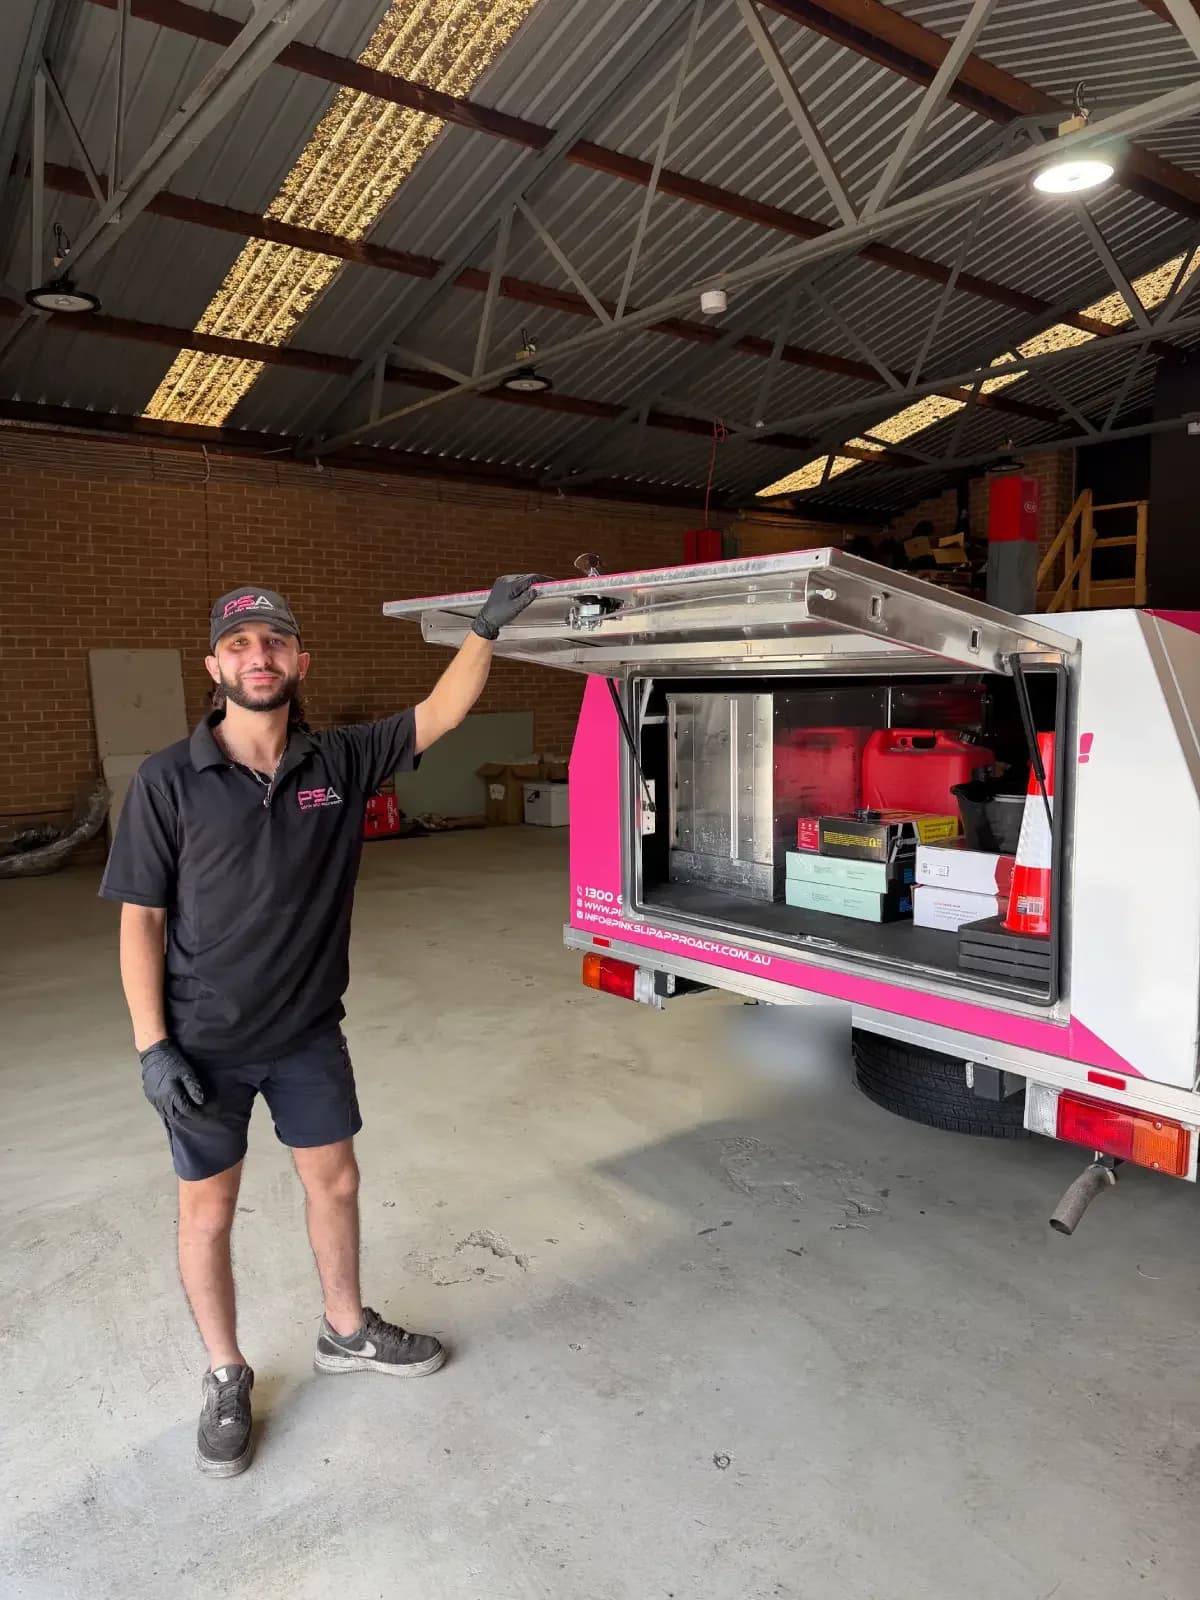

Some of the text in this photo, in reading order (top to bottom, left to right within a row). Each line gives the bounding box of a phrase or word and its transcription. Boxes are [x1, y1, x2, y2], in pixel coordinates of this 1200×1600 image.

[224, 595, 274, 617] PSA
[298, 786, 341, 805] PSA
[585, 887, 613, 903] 1300
[584, 913, 772, 966] INFO@PINKSLIPAPPROACH.COM.AU
